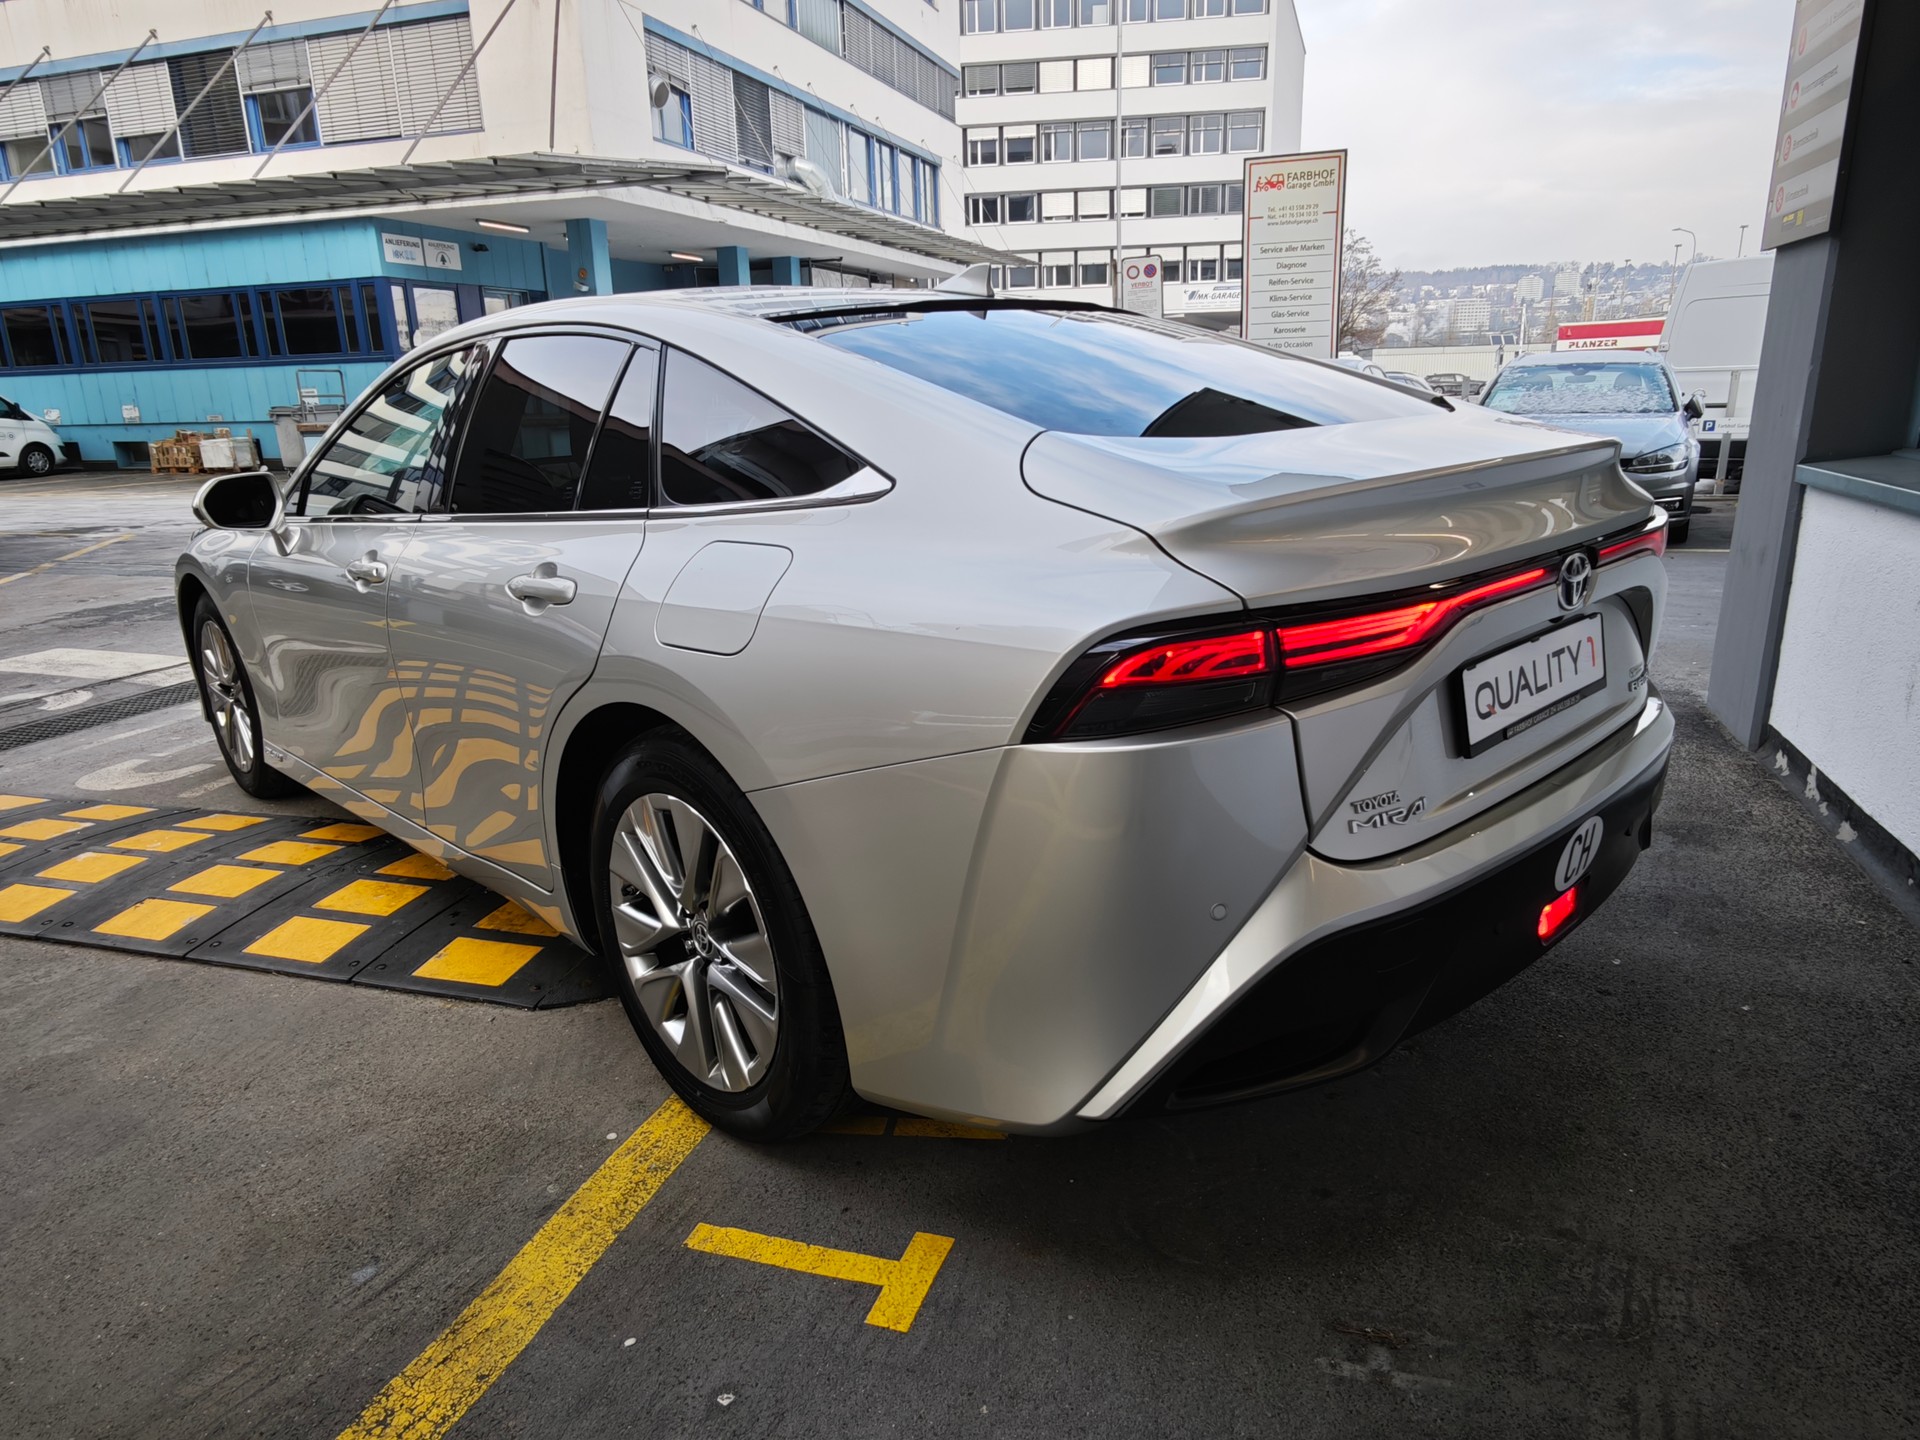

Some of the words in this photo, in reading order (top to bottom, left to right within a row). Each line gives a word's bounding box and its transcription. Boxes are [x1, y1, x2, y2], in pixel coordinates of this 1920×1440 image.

[1287, 169, 1335, 182] FARBHOF
[1286, 181, 1312, 190] Garage
[1313, 179, 1335, 188] GmbH
[385, 238, 420, 249] ANLIEFERUNG
[1260, 245, 1283, 254] Service
[1300, 244, 1325, 252] Marken
[1276, 262, 1307, 270] Diagnose
[1269, 278, 1314, 286] Reifen-Service
[1269, 294, 1313, 302] Klima-Service
[1271, 310, 1310, 318] Glas-Service
[1273, 326, 1306, 334] Karosserie
[1568, 339, 1618, 348] PLANZER
[1475, 640, 1582, 720] QUALITY
[1350, 790, 1400, 814] TOYOTA
[1564, 822, 1597, 884] CH
